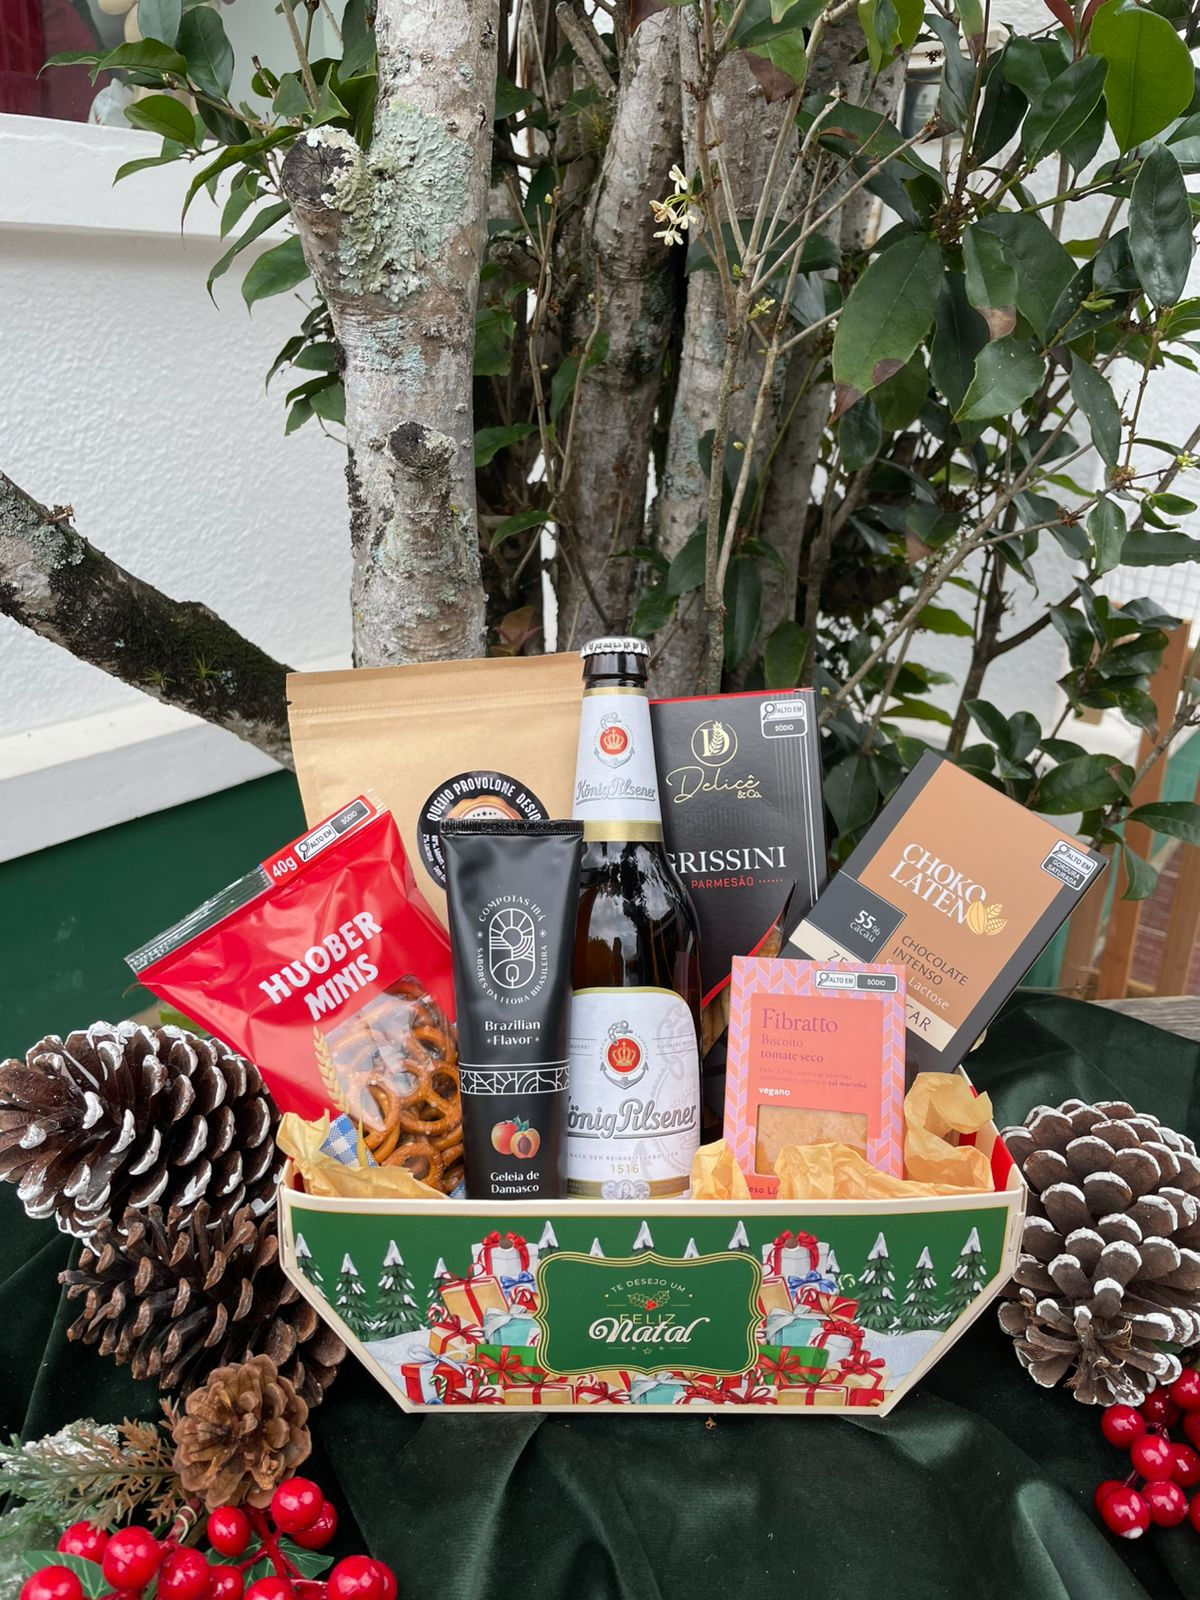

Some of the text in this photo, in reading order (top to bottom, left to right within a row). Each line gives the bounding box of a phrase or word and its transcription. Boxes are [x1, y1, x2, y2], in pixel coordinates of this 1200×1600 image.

[777, 705, 802, 714] ALTO EM
[775, 723, 794, 732] SÓDIO
[427, 788, 455, 822] QUEIJO
[452, 776, 516, 797] PROVOLONE
[576, 777, 655, 800] König Pilsener
[341, 810, 358, 825] SÓDIO
[310, 829, 333, 849] ALTO EM
[272, 856, 298, 877] 40g
[1052, 859, 1081, 880] GORDURA
[1066, 853, 1082, 865] ALTO
[691, 875, 755, 889] PARMESÃO
[903, 843, 987, 903] CHOKO
[1046, 864, 1077, 886] SATURADA
[889, 860, 968, 924] LATEN
[478, 894, 530, 923] COMPOTAS
[849, 921, 876, 943] cacau
[854, 910, 881, 937] 55%
[258, 911, 383, 1005] HUOBER
[892, 946, 943, 986] INTENSO
[901, 935, 969, 986] CHOCOLATE
[476, 947, 488, 989] SABORES
[486, 988, 499, 1001] DA
[531, 944, 549, 997] BRASILEIRA
[867, 978, 886, 986] SÓDIO
[303, 953, 379, 1021] MINIS
[908, 976, 949, 1010] Lactose
[485, 1020, 541, 1032] Brazilian
[762, 1008, 838, 1033] Fibratto
[493, 1035, 533, 1046] Flavor
[761, 1034, 803, 1047] Biscoito
[760, 1050, 824, 1063] tomate seco
[758, 1086, 791, 1097] vegano
[568, 1096, 697, 1139] önig Pilsener
[490, 1170, 540, 1181] Geleia de
[610, 1164, 640, 1174] 1516
[491, 1184, 540, 1193] Damasco
[611, 1278, 687, 1293] TE DESEJO UM
[620, 1313, 676, 1325] FELIZ
[588, 1316, 711, 1344] Natal
